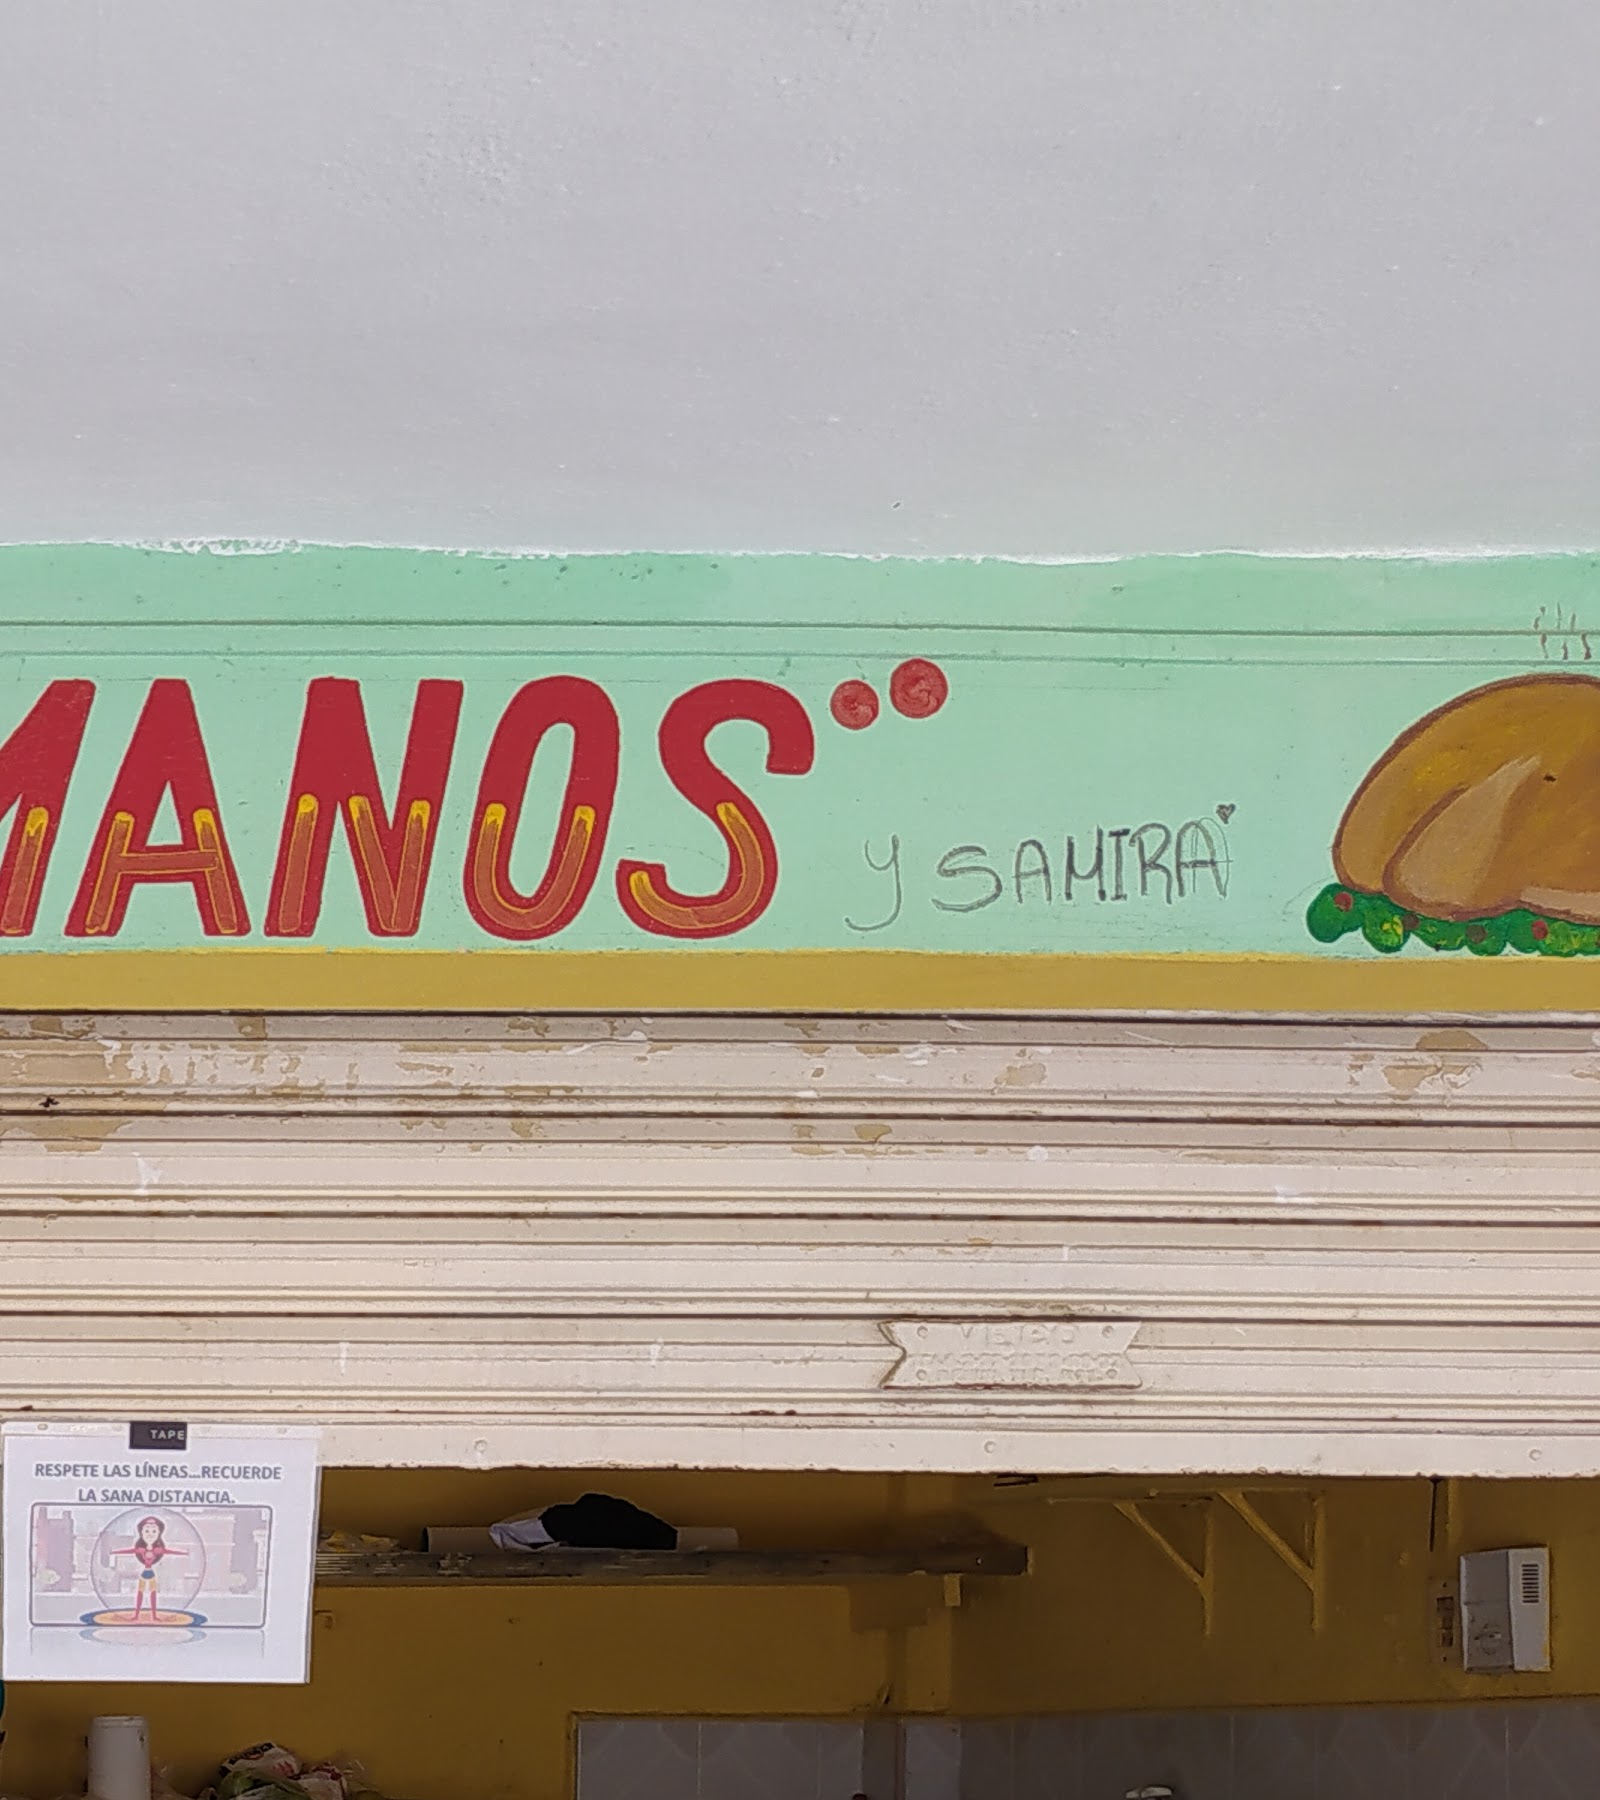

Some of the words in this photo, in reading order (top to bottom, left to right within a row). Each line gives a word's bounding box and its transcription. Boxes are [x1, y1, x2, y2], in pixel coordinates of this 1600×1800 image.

[150, 1429, 185, 1440] TAPE
[35, 1463, 99, 1478] RESPETE
[103, 1464, 131, 1478] LAS
[78, 1488, 97, 1502] LA
[101, 1489, 144, 1503] SANA
[148, 1490, 236, 1504] DISTANCIA.
